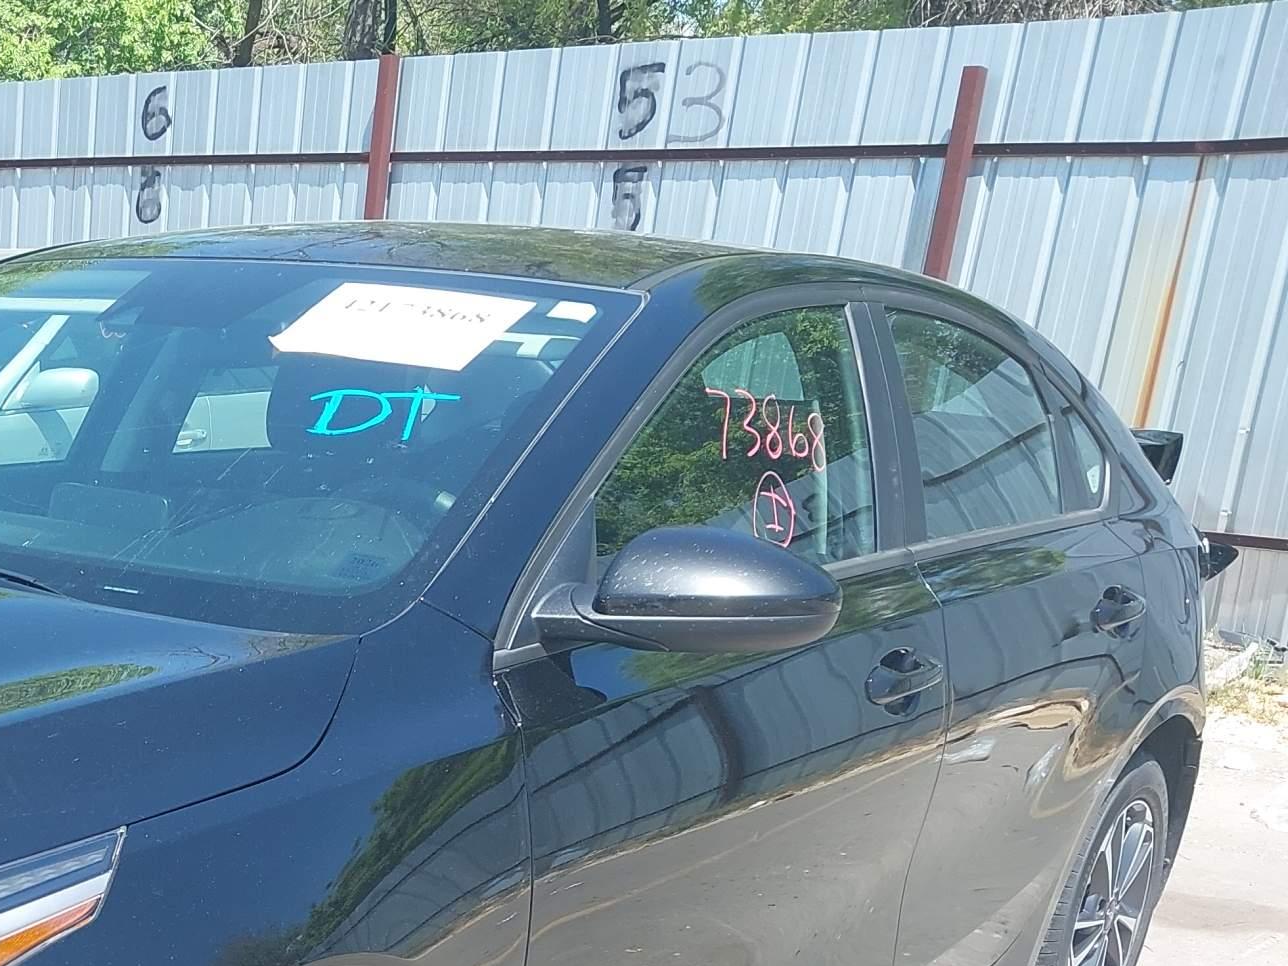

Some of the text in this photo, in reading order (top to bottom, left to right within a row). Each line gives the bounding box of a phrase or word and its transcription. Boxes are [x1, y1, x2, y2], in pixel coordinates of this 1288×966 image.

[141, 85, 173, 142] 6
[305, 388, 461, 441] DT
[705, 386, 828, 472] 73868
